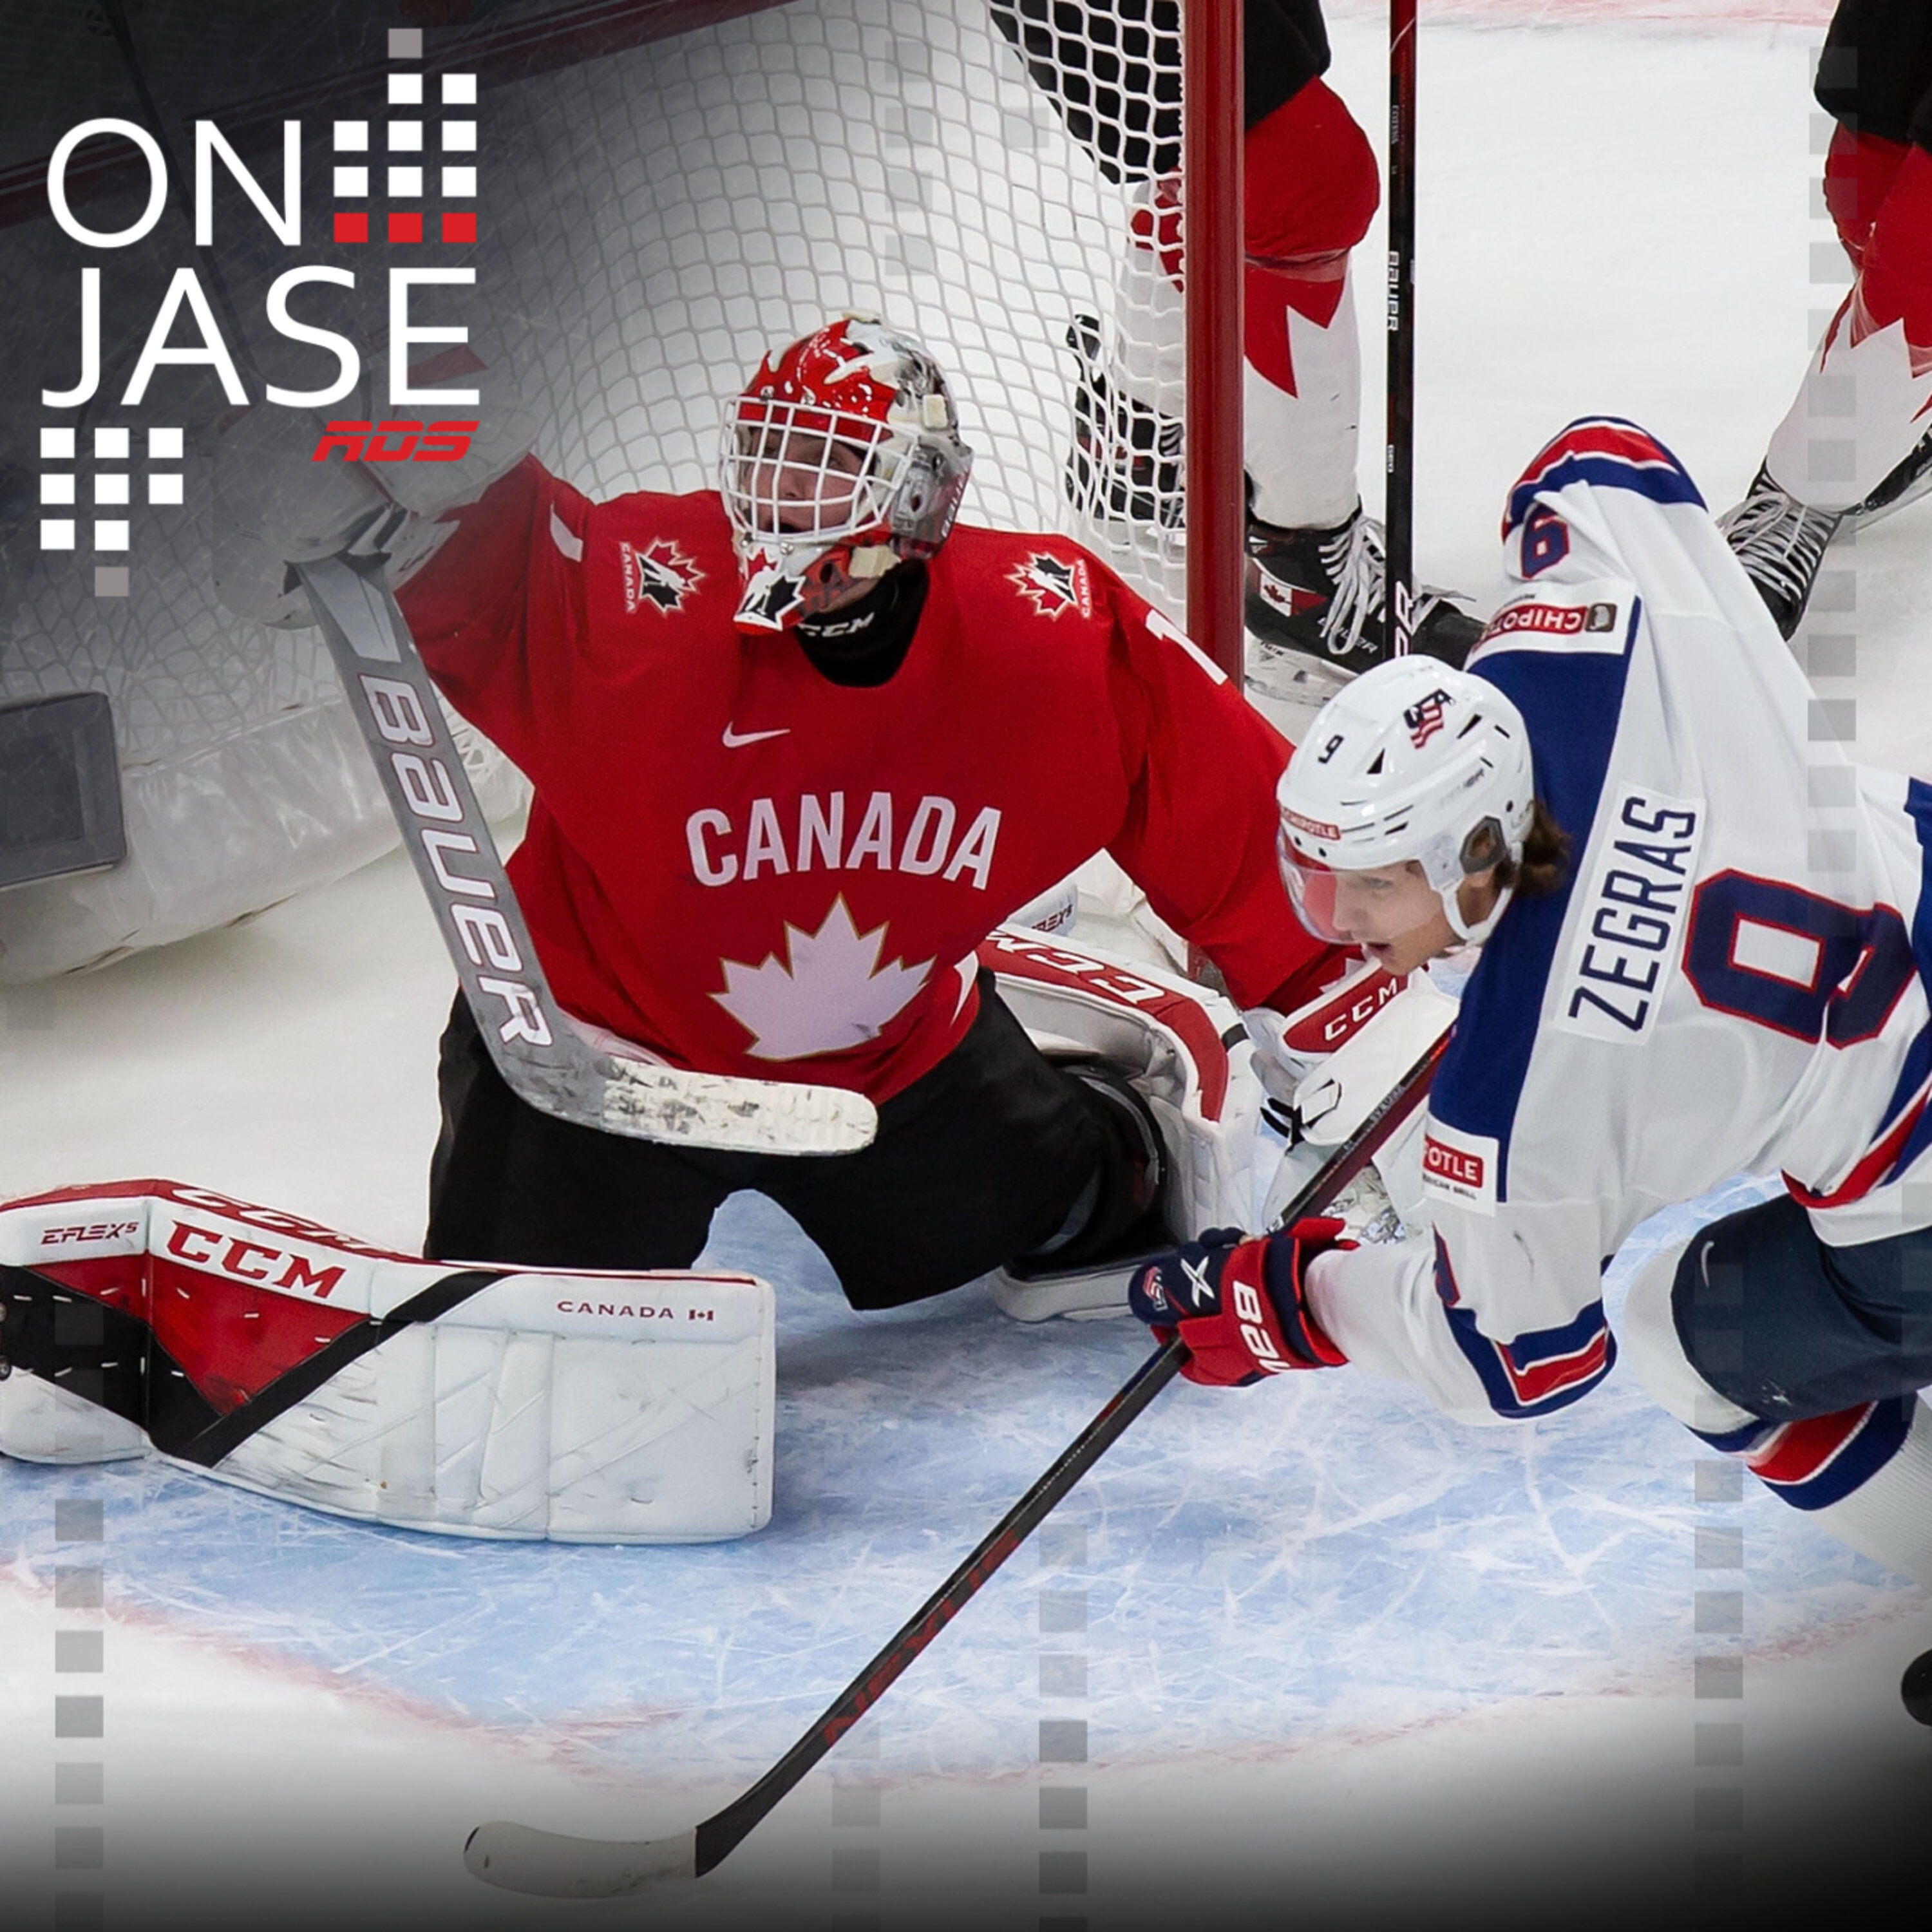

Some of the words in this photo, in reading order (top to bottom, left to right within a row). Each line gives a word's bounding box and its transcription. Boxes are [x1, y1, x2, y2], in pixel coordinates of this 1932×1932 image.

[621, 542, 636, 611] CANADA
[1077, 558, 1091, 618] CANADA
[798, 612, 875, 638] CCM
[1318, 735, 1344, 764] 9
[359, 674, 553, 1047] BAUER
[685, 791, 1001, 891] CANADA
[1568, 797, 1696, 1032] ZEGRAS
[1681, 867, 1919, 1051] 9
[1325, 978, 1397, 1041] CCM
[166, 1219, 346, 1299] CCM
[557, 1301, 674, 1319] CANADA
